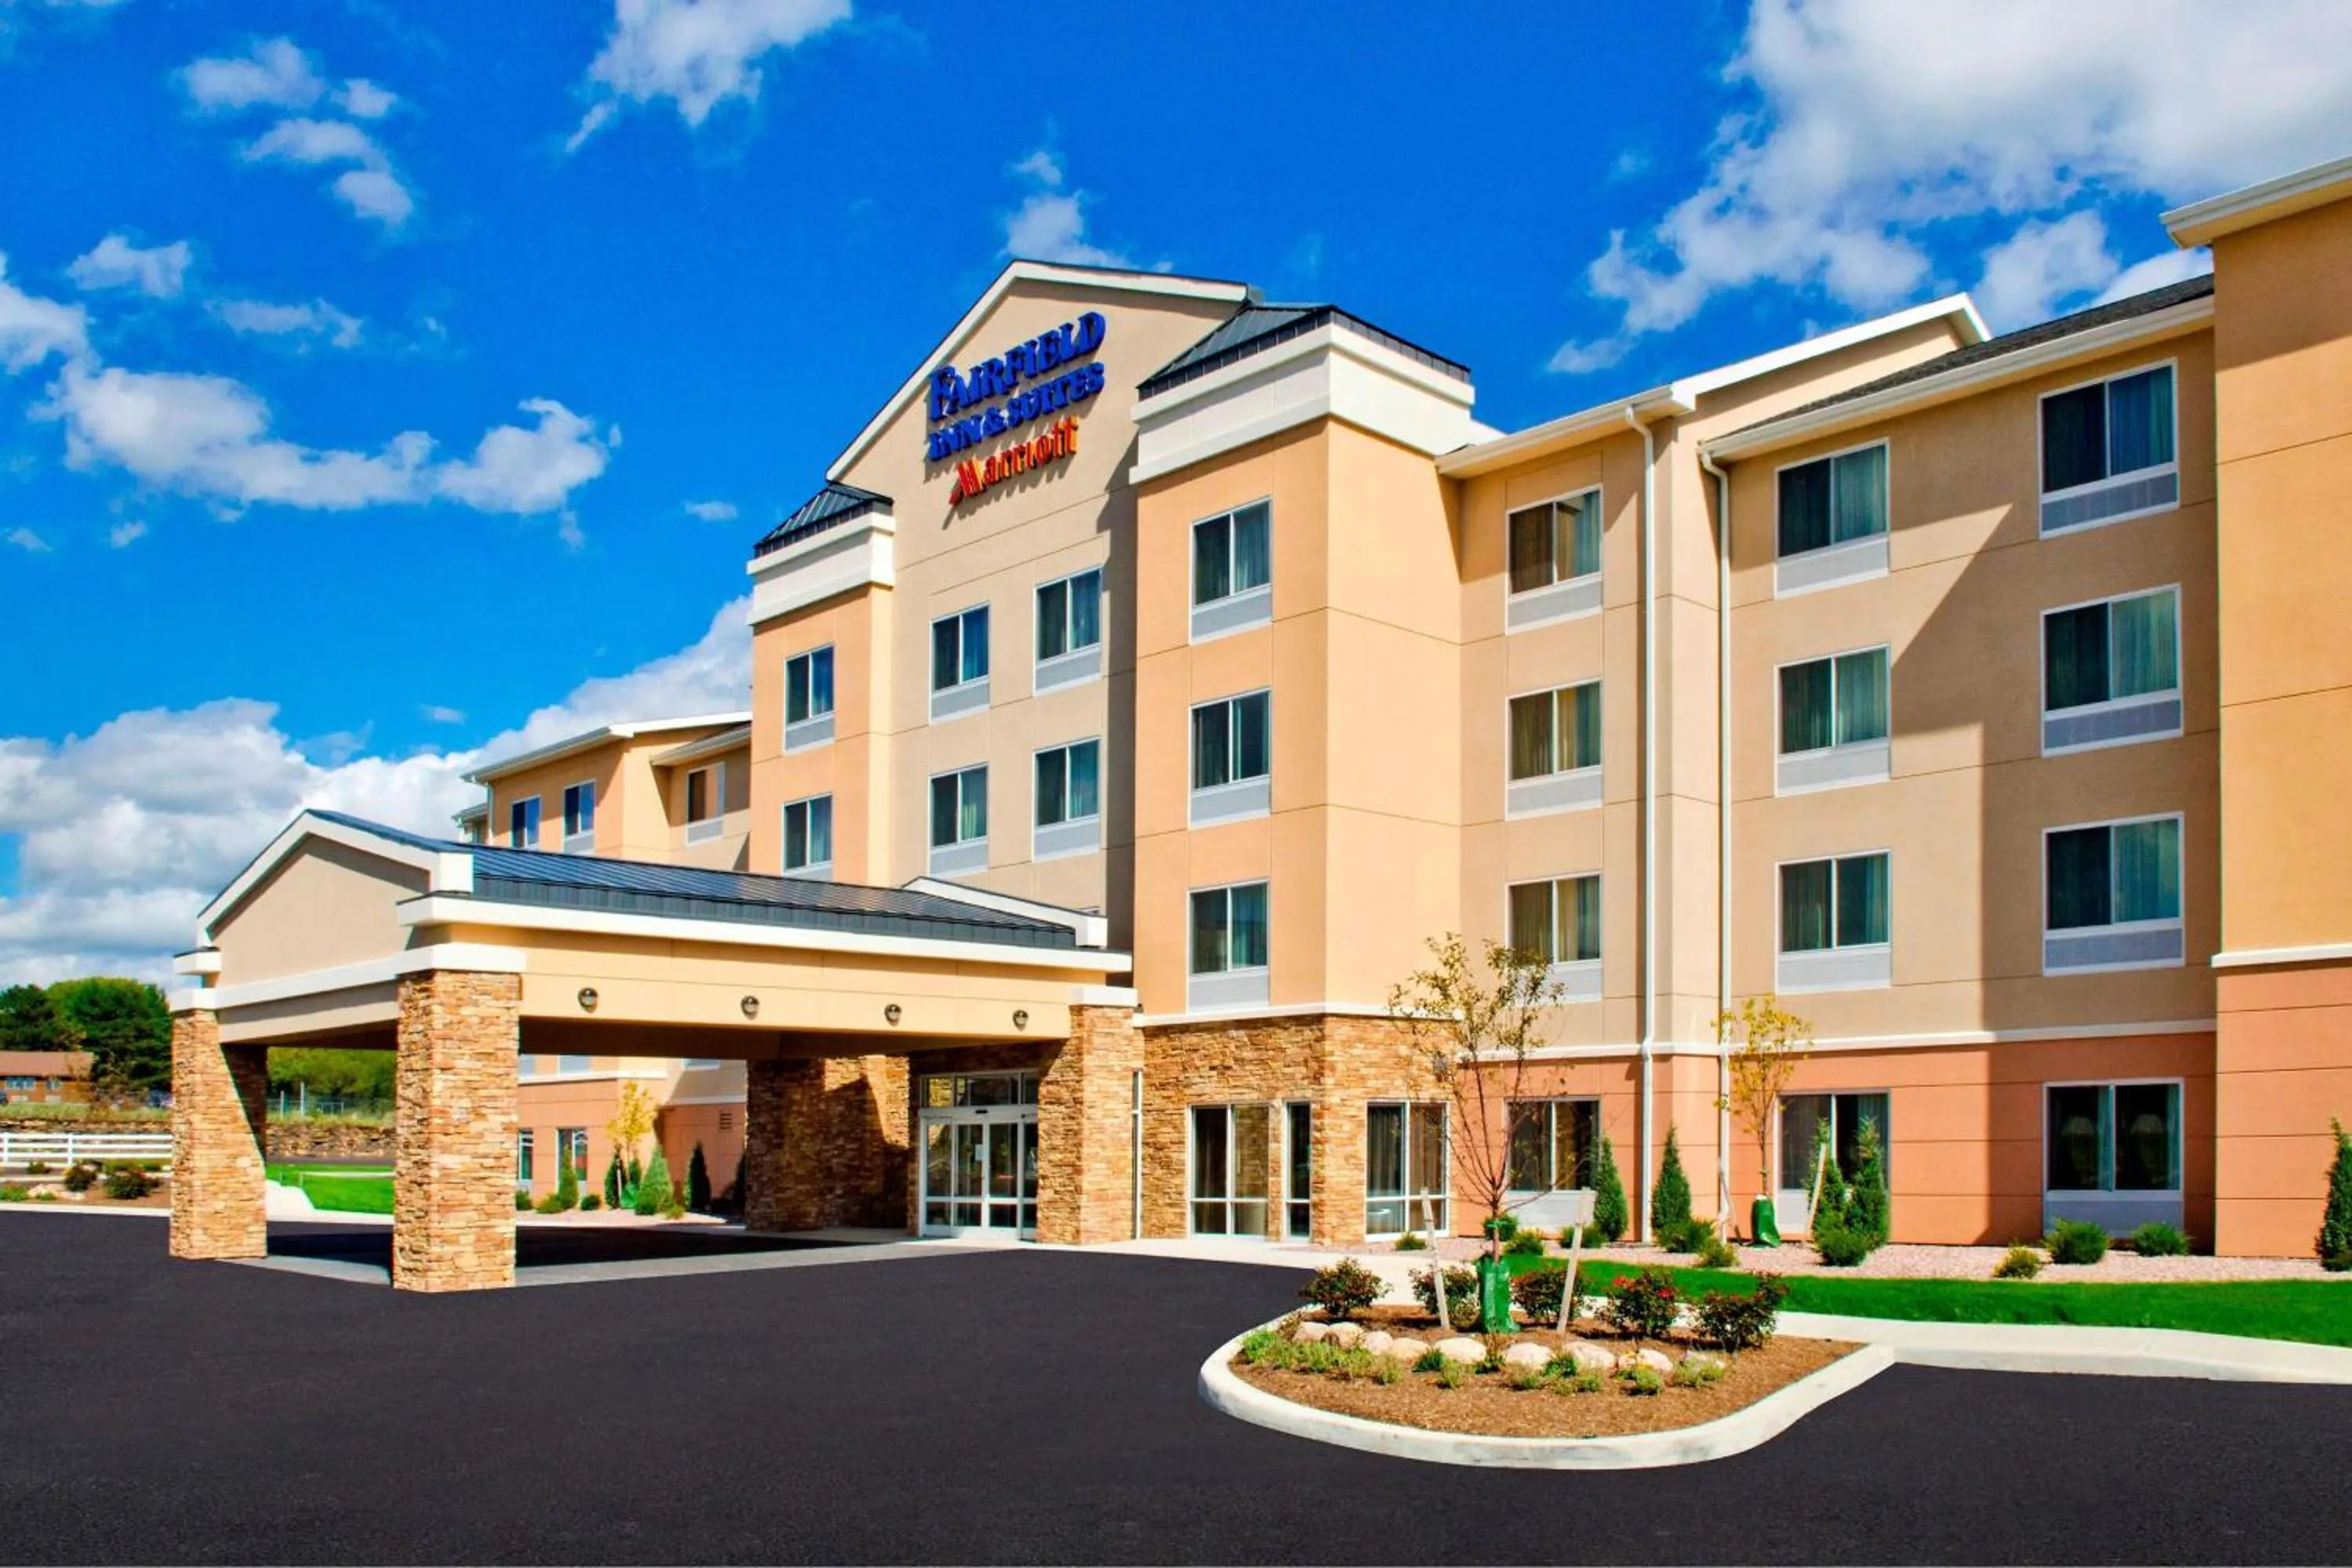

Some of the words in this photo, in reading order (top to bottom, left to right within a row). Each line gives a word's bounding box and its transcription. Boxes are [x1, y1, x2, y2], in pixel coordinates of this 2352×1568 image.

[927, 412, 983, 461] INN
[1007, 362, 1105, 428] SUITES
[928, 312, 1106, 422] FAIRFIELD
[949, 415, 1080, 506] Marriott
